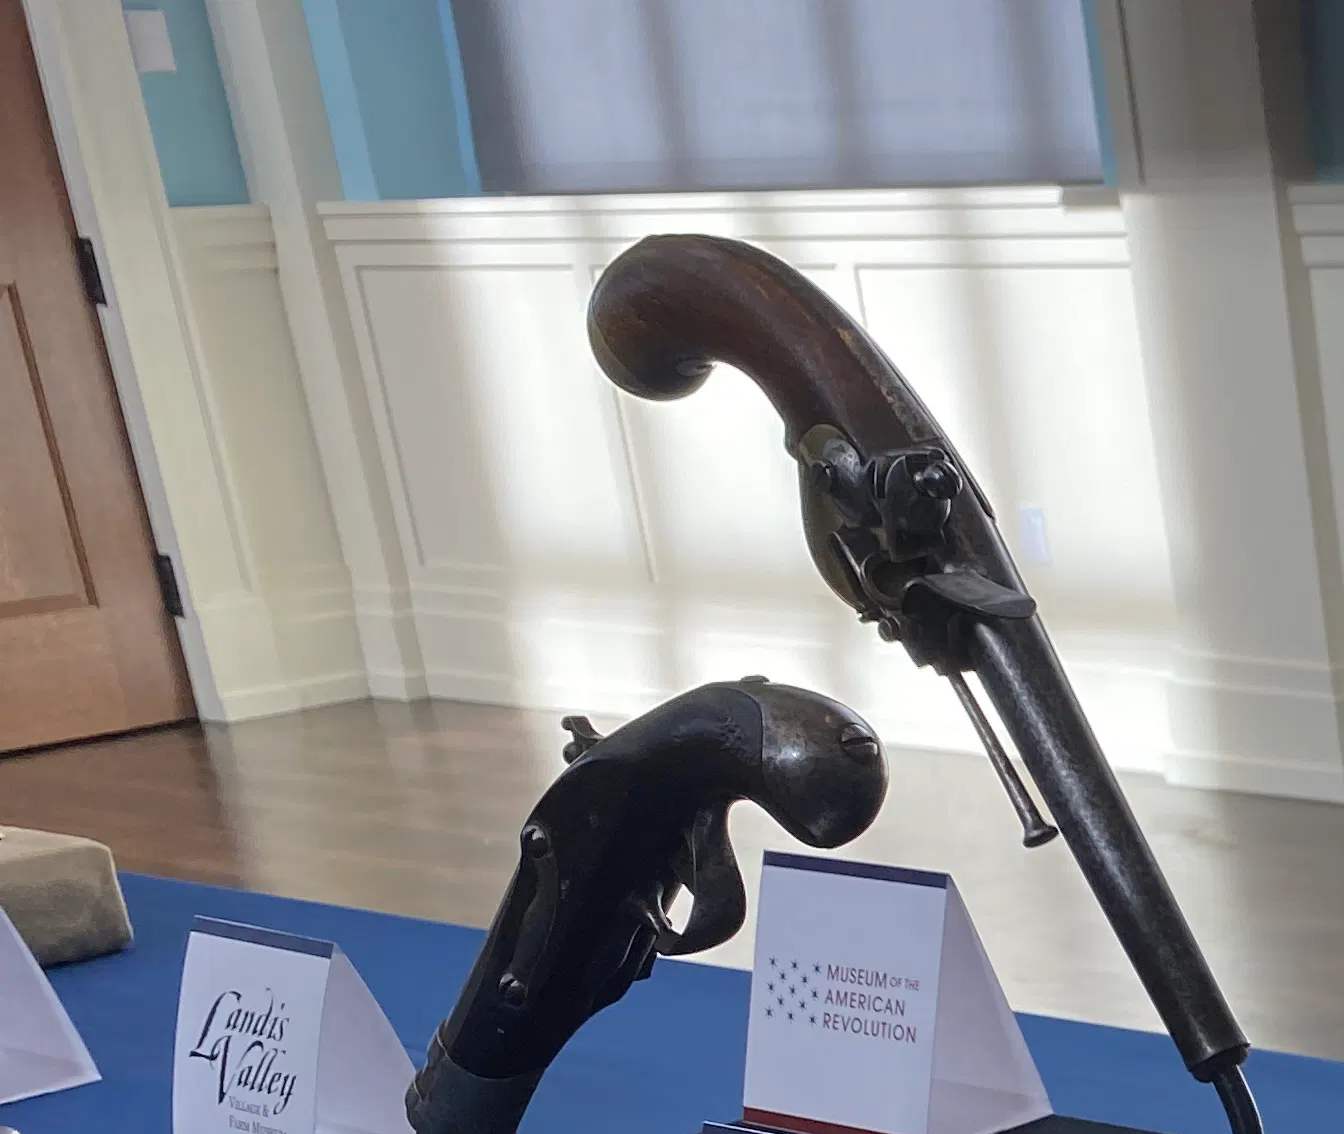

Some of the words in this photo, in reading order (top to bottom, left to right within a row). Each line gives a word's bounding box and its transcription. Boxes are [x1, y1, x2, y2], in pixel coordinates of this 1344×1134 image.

[827, 964, 887, 989] MUSEUM
[889, 976, 903, 988] OF
[905, 978, 920, 992] THE
[824, 988, 905, 1016] AMERICAN
[189, 987, 290, 1061] Landis
[823, 1012, 917, 1044] REVOLUTION
[209, 1035, 297, 1115] Valley
